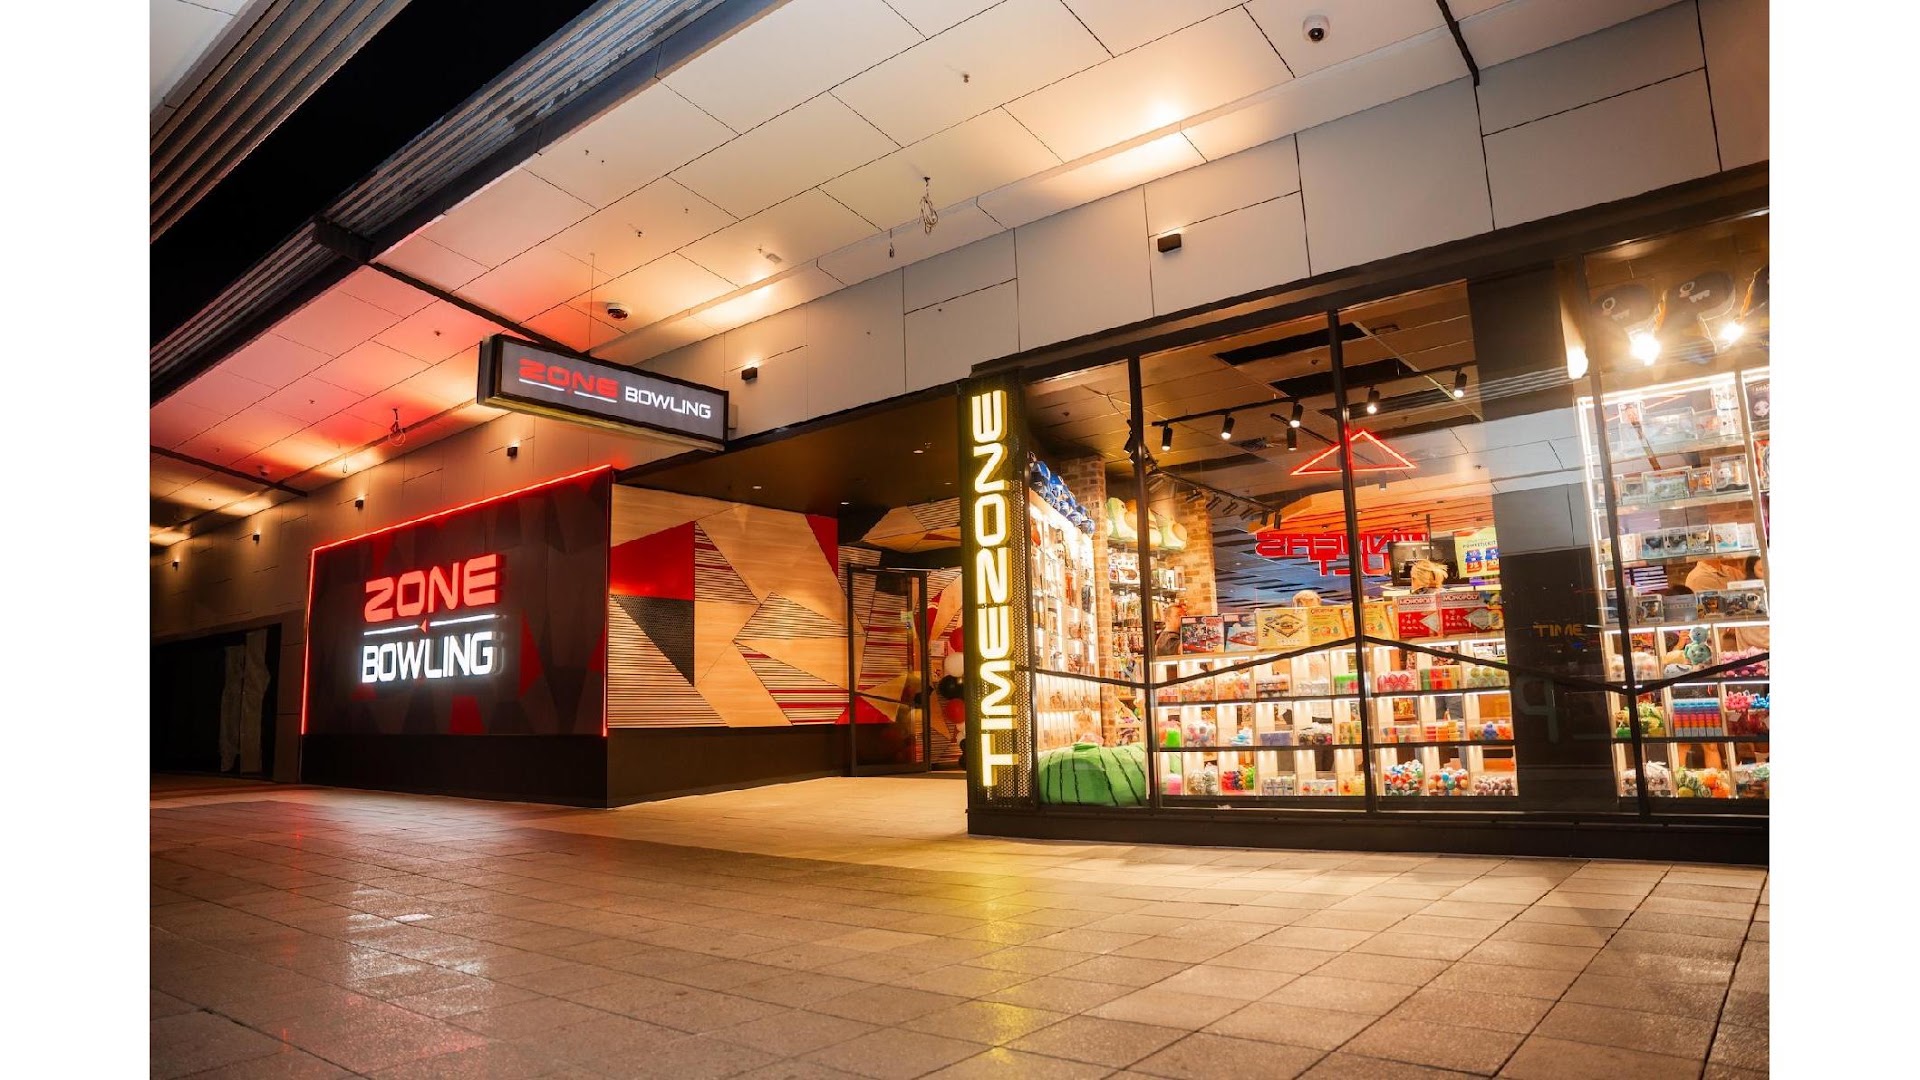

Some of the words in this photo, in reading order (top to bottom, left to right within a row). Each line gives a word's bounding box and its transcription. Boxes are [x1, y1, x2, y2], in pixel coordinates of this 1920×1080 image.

[518, 358, 619, 398] ZONE
[625, 386, 711, 419] BOWLING
[364, 554, 498, 623] ZONE
[972, 390, 1017, 787] TIMEZONE
[1443, 593, 1478, 601] MONOPOLY
[362, 631, 493, 683] BOWLING
[1532, 623, 1584, 637] TIME
